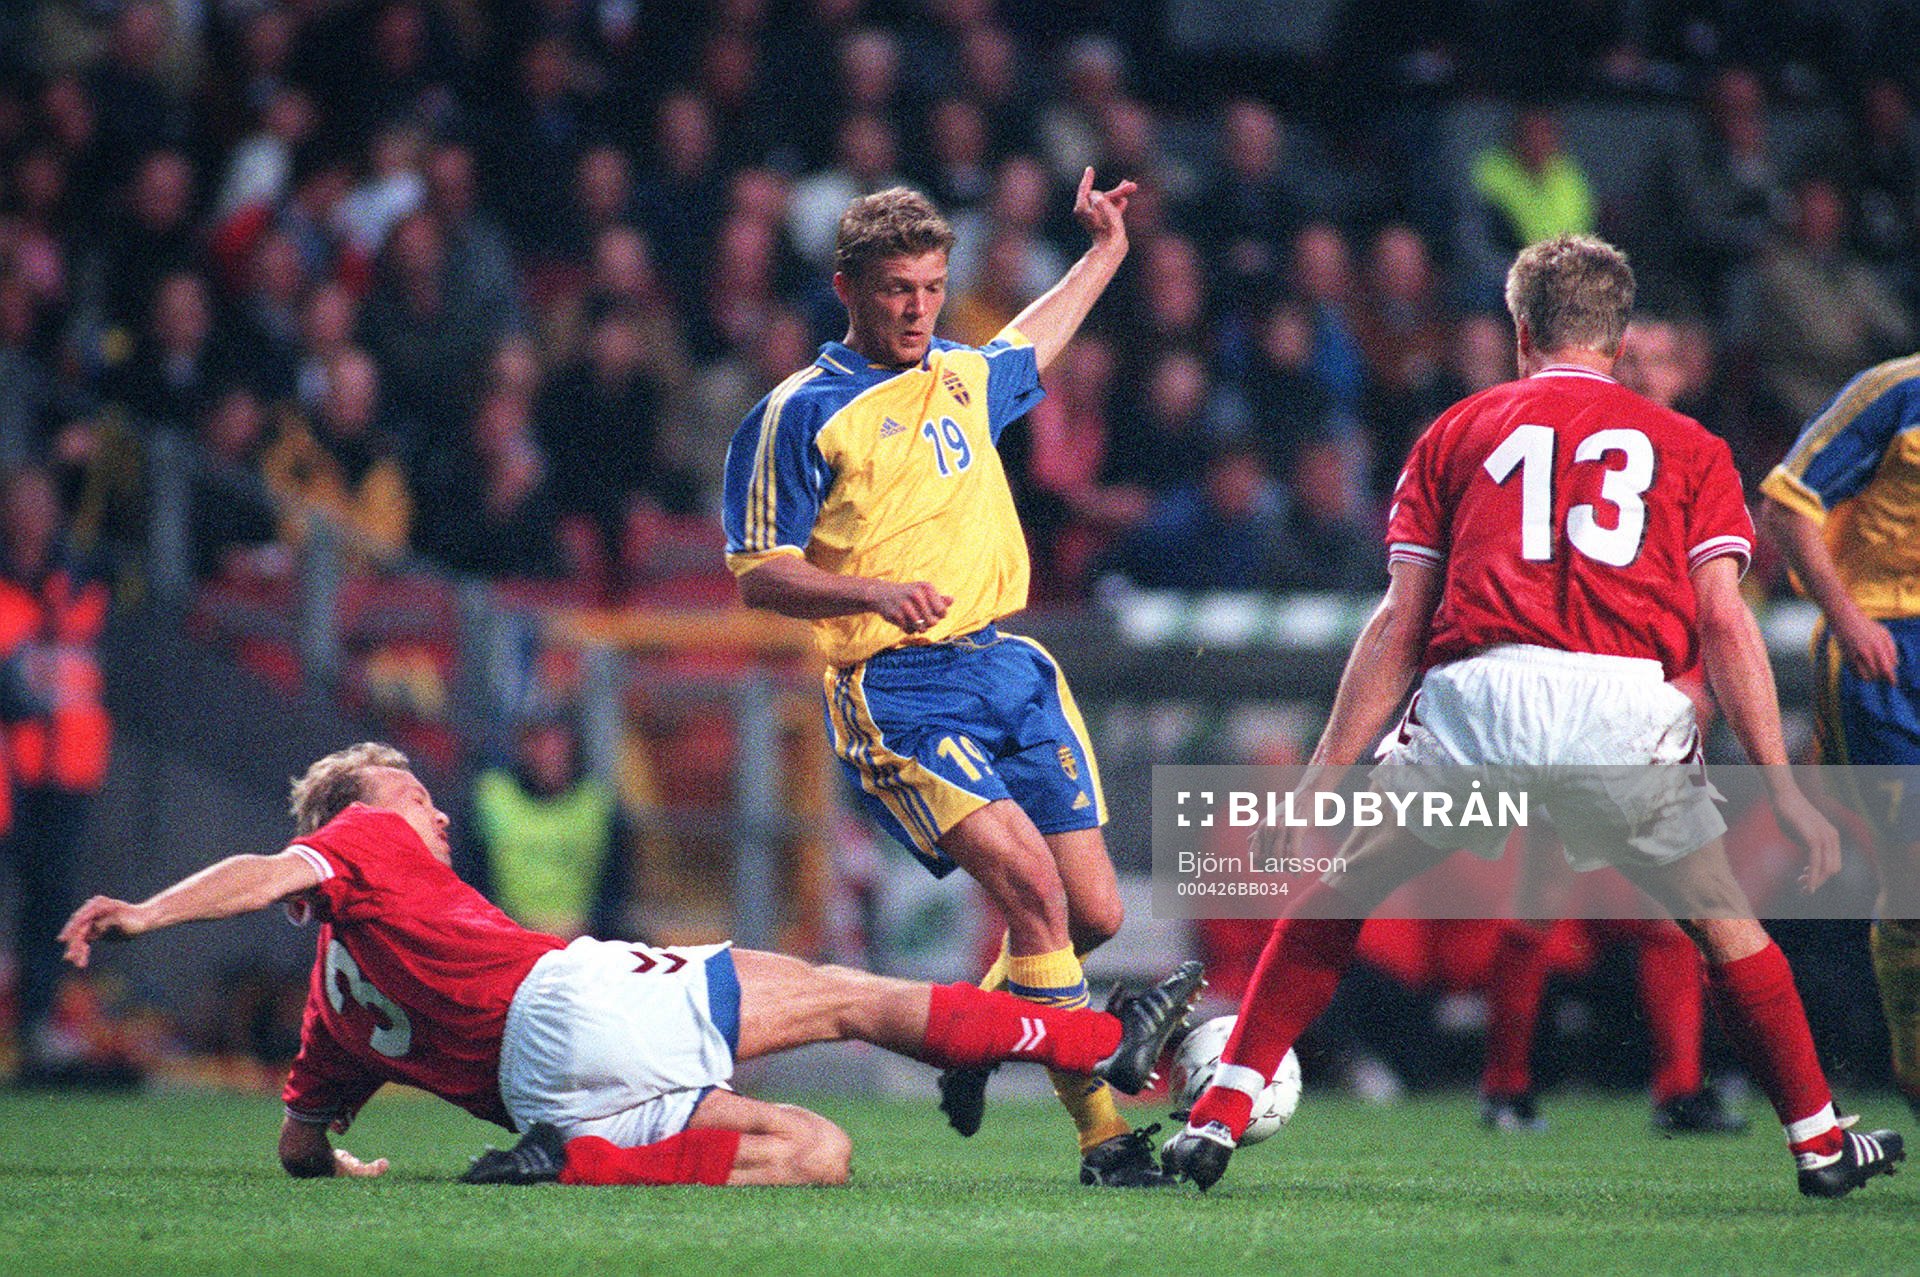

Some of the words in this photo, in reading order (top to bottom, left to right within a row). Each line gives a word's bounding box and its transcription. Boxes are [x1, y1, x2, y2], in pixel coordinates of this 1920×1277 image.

[921, 414, 974, 479] 19
[1483, 424, 1656, 567] 13
[325, 938, 412, 1058] 3
